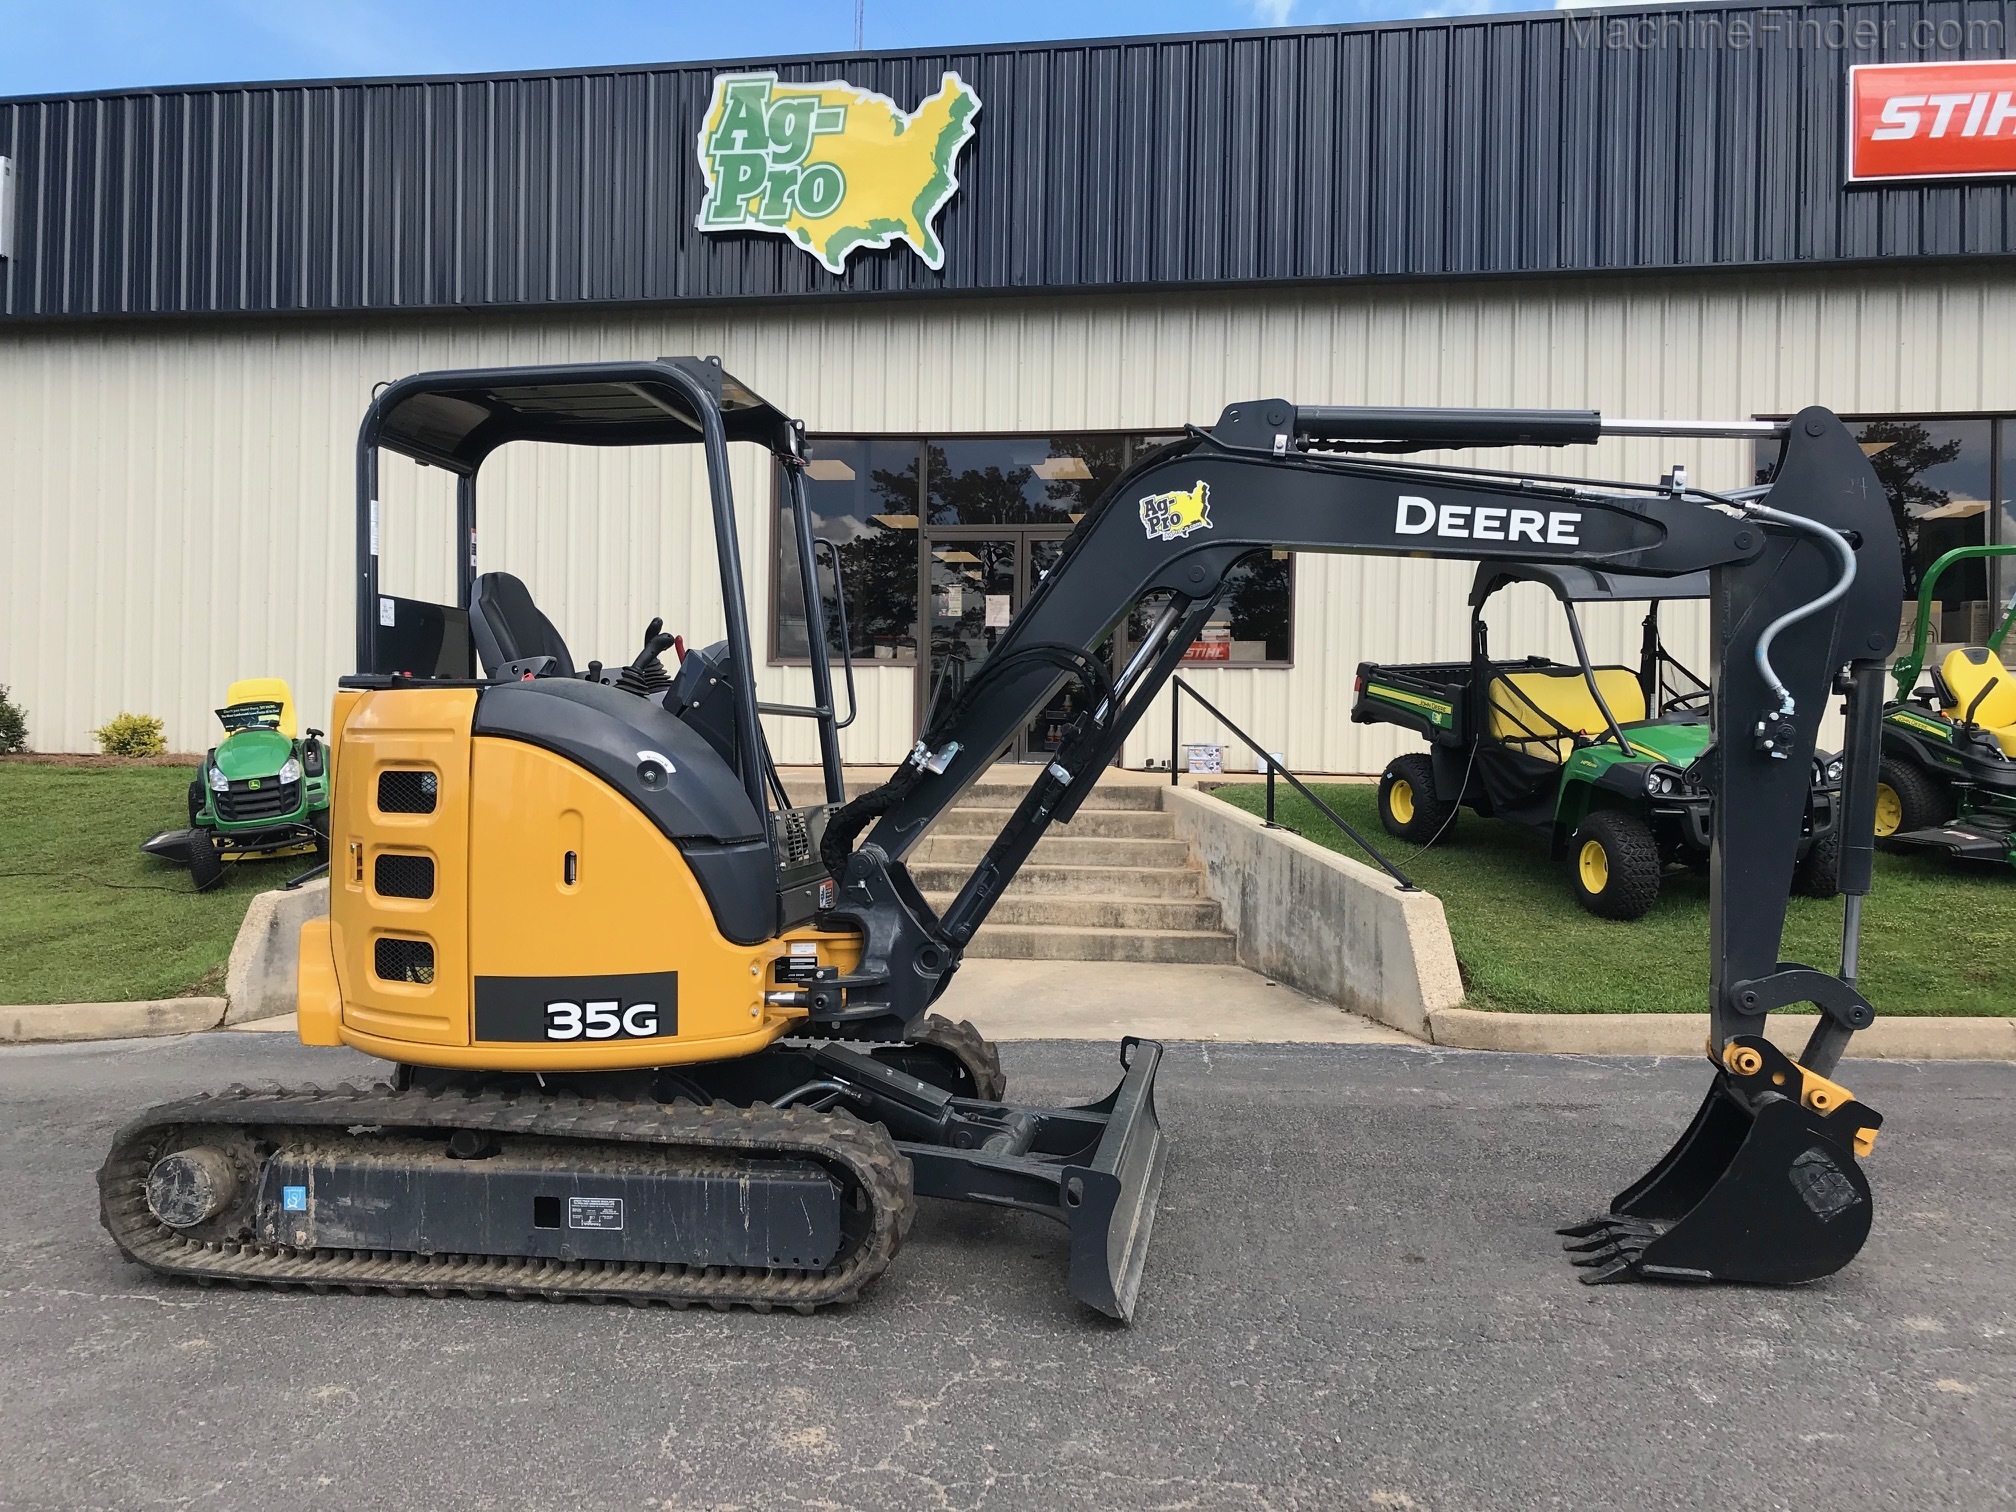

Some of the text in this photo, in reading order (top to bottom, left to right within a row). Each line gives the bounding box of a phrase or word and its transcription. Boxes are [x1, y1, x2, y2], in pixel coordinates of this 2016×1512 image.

[709, 81, 845, 165] Ag-
[709, 153, 845, 221] Pro
[1144, 497, 1176, 518] Ag-
[1395, 495, 1582, 545] DEERE
[1147, 513, 1181, 535] Pro
[1184, 647, 1223, 658] STIHL
[1419, 700, 1447, 712] JOHN DEERE
[546, 1000, 658, 1040] 35G
